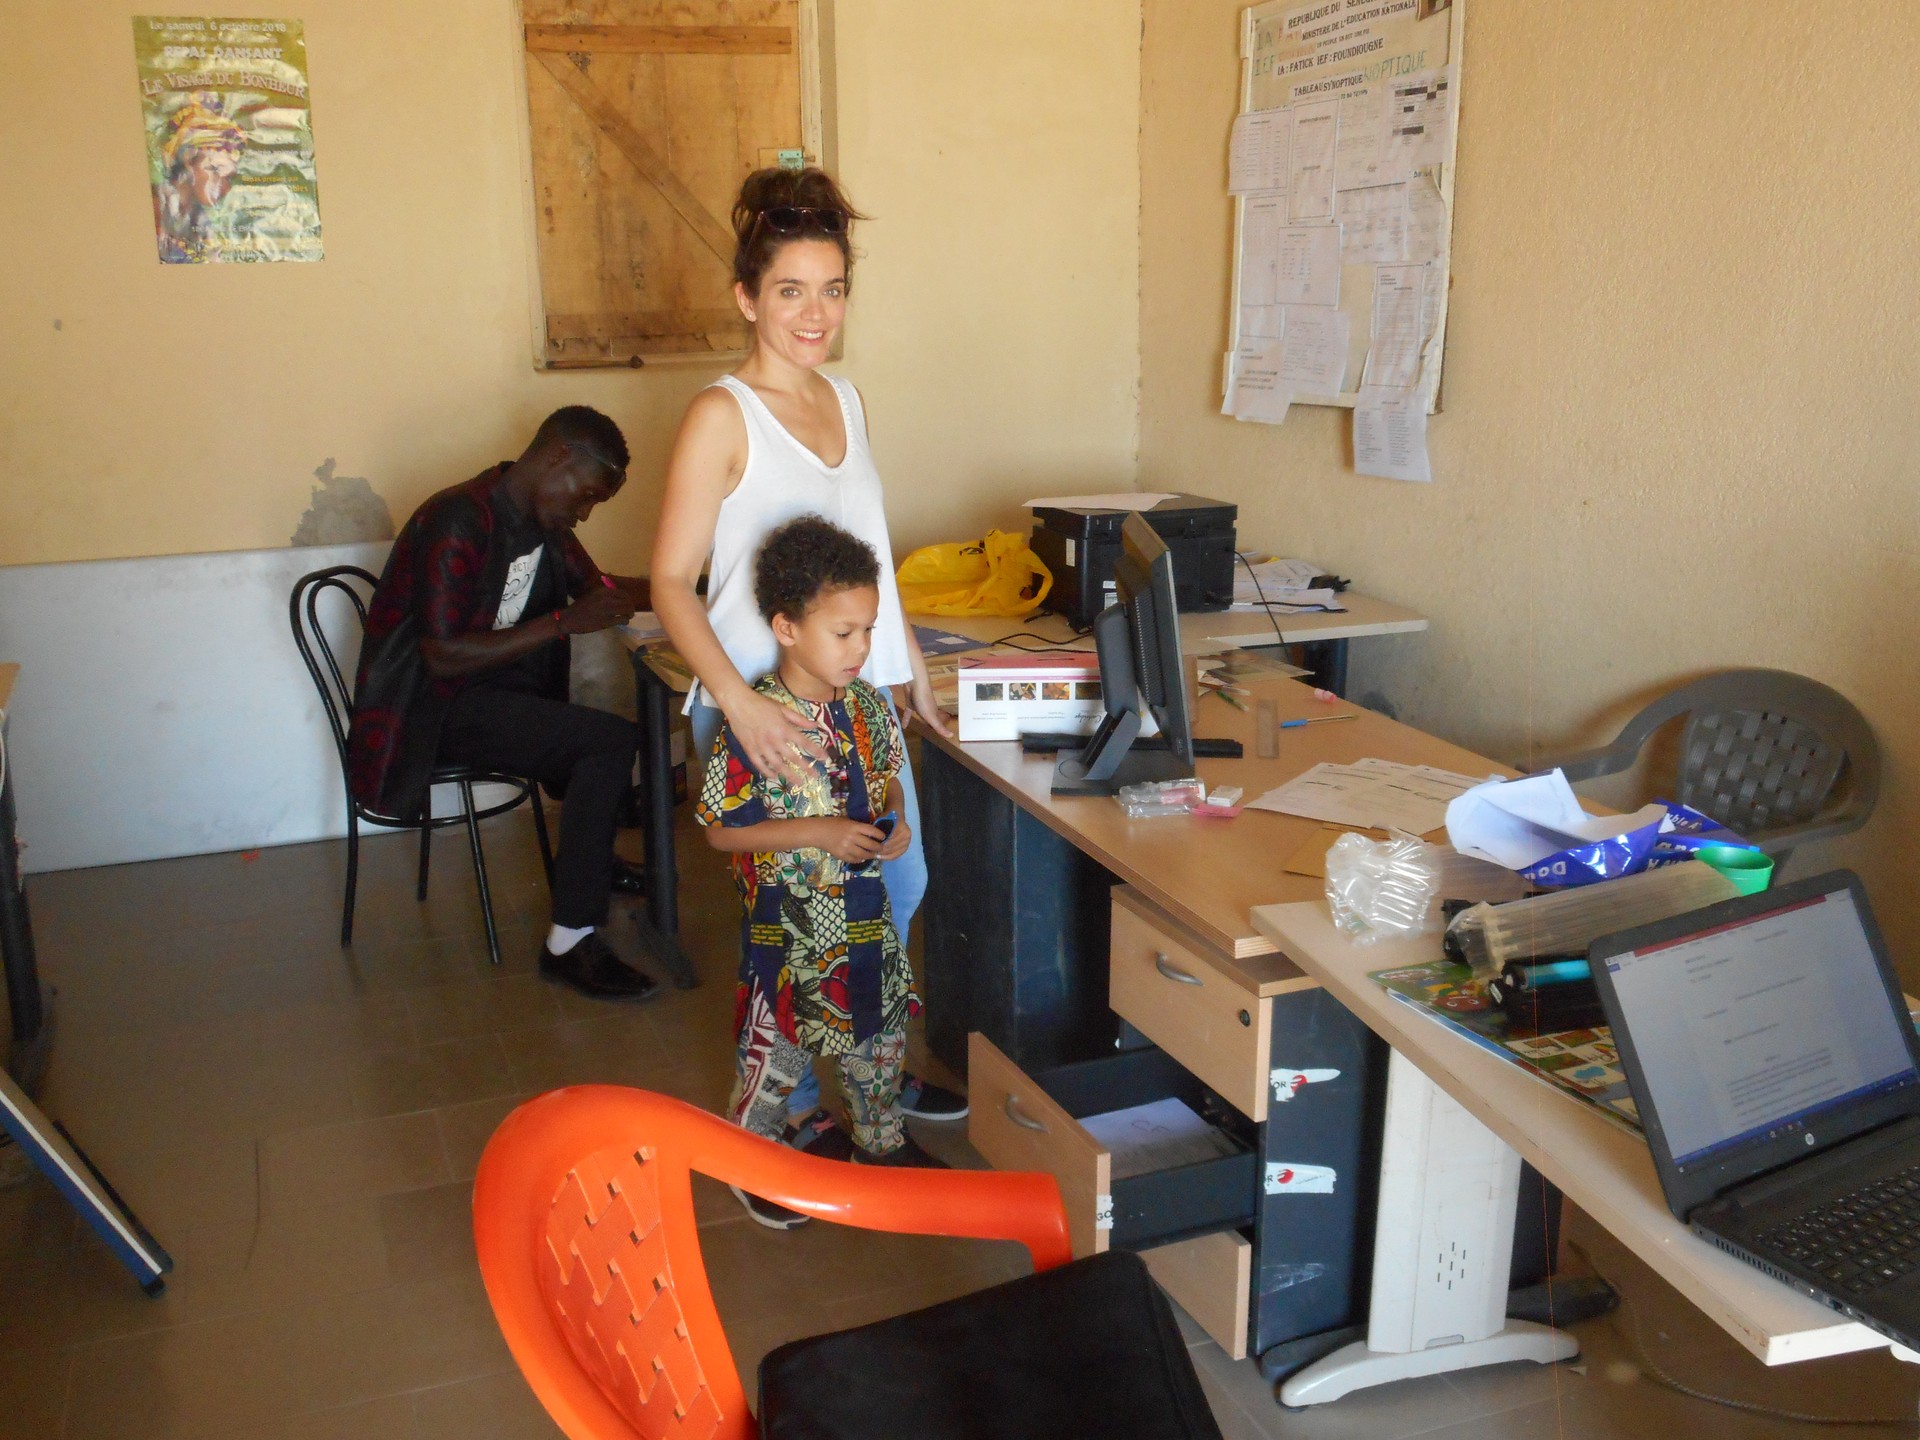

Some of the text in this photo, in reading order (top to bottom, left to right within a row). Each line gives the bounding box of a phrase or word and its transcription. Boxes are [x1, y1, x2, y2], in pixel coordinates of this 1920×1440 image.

[150, 21, 163, 31] Le
[167, 21, 205, 31] samedi
[210, 22, 217, 31] 6
[219, 22, 260, 32] octobre
[1288, 5, 1330, 30] REPUBLIQUE
[1331, 1, 1341, 14] DU
[1302, 24, 1331, 41] MINISTERE
[1331, 21, 1340, 32] DE
[1332, 37, 1384, 63] FOUNDIOUGNE
[141, 71, 306, 98] LE VISAGE DU BONHEUR
